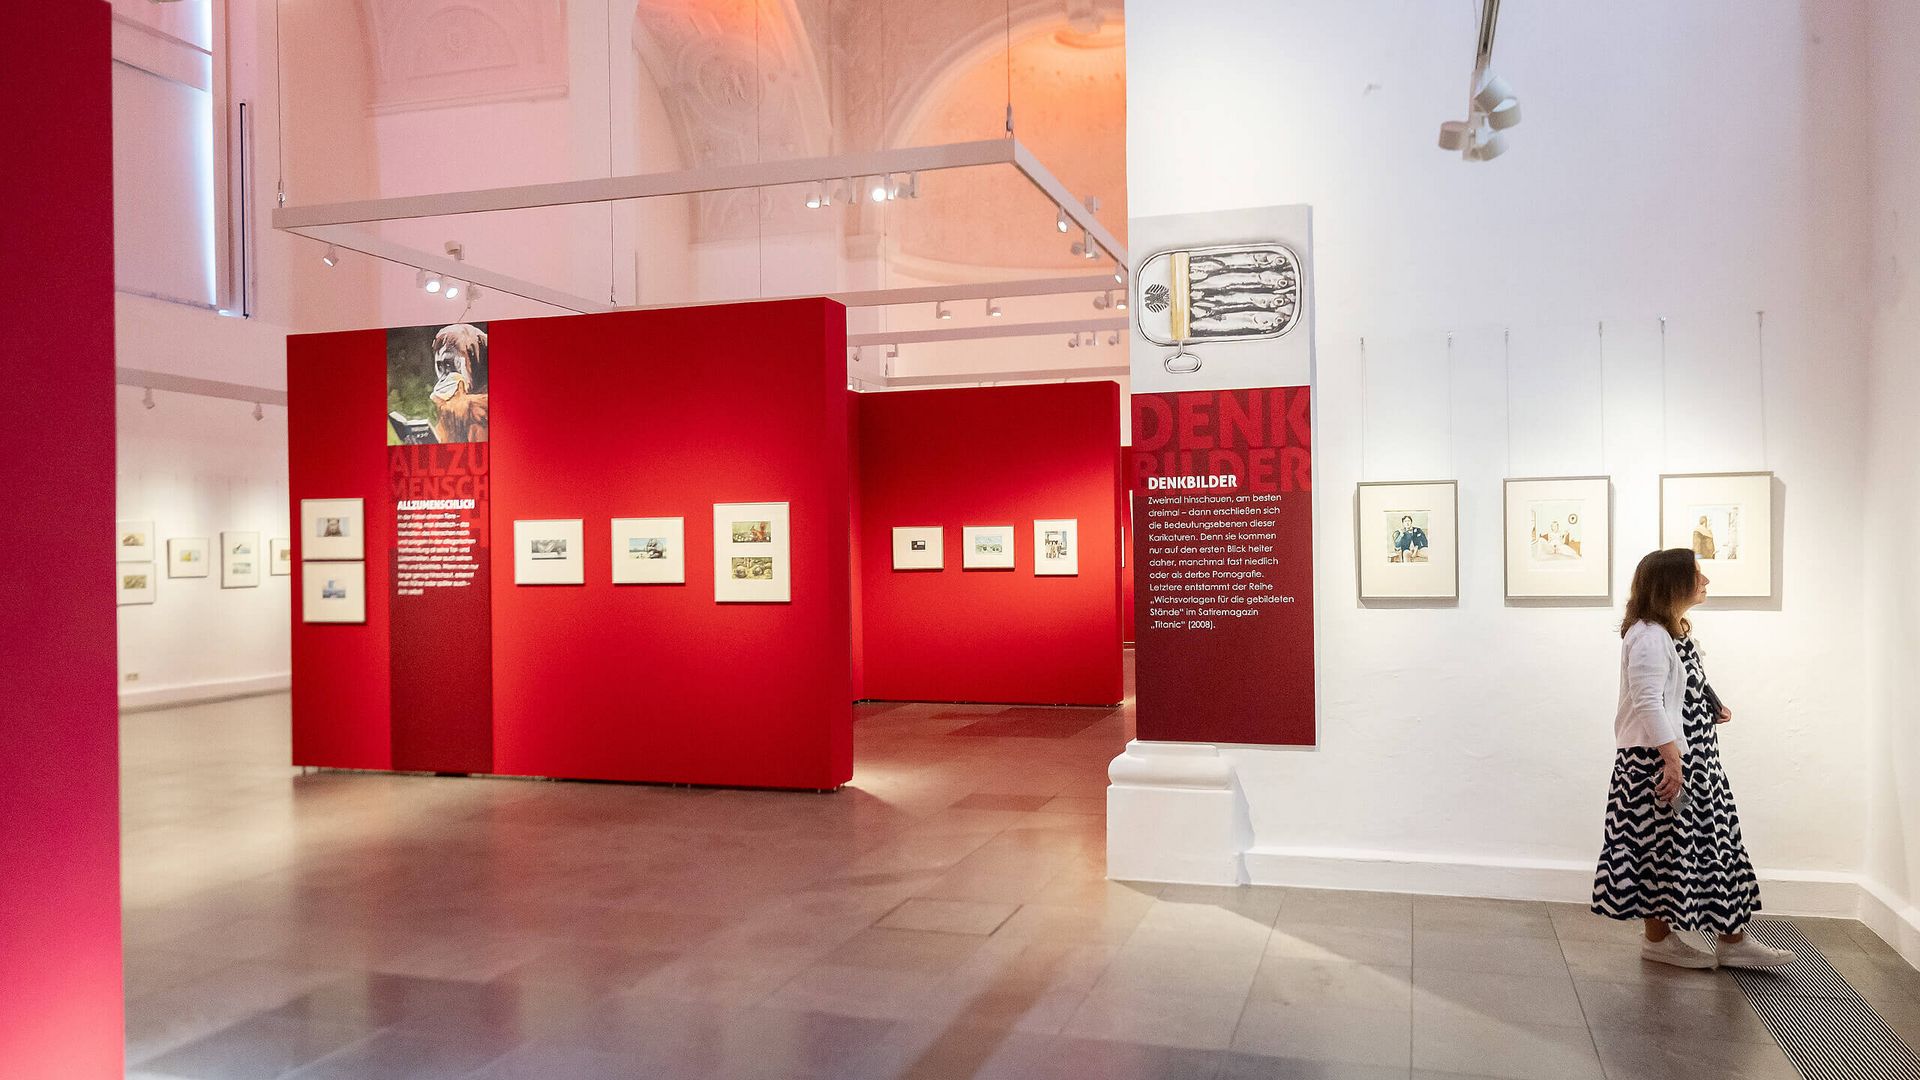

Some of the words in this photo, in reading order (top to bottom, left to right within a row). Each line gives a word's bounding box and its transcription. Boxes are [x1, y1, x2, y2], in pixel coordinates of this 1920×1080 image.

[1134, 386, 1310, 451] DENK
[389, 442, 488, 477] ALLZU
[1132, 446, 1311, 496] BILDER
[1148, 475, 1237, 490] DENKBILDER
[1148, 495, 1181, 504] Zweimal
[1183, 495, 1234, 503] hinschauen,
[1252, 493, 1281, 501] besten
[397, 499, 475, 511] ALLZUMENSCHLICH
[1148, 508, 1179, 517] dreimal
[1188, 507, 1211, 515] dann
[1212, 506, 1261, 515] erschließen
[1263, 506, 1280, 514] sich
[1148, 521, 1162, 529] die
[1164, 520, 1247, 529] Bedeutungsebenen
[1249, 518, 1275, 527] dieser
[1148, 533, 1198, 541] Karikaturen.
[1200, 532, 1223, 540] Denn
[1224, 532, 1237, 540] sie
[1238, 532, 1276, 540] kommen
[1164, 545, 1179, 553] auf
[1179, 545, 1198, 553] den
[1198, 545, 1225, 553] ersten
[1227, 544, 1246, 552] Blick
[1248, 544, 1273, 552] heiter
[1149, 558, 1176, 566] daher,
[1178, 557, 1224, 565] manchmal
[1226, 557, 1242, 565] fast
[1244, 556, 1278, 565] niedlich
[1171, 570, 1183, 578] als
[1184, 570, 1210, 578] derbe
[1212, 569, 1264, 579] Pornografie.
[1149, 583, 1182, 591] Letztere
[1231, 582, 1248, 590] der
[1248, 582, 1273, 590] Reihe
[1217, 594, 1229, 603] für
[1230, 595, 1245, 603] die
[1246, 594, 1294, 605] gebildeten
[1197, 607, 1258, 617] Satiremagazin
[1188, 620, 1215, 629] (2008).
